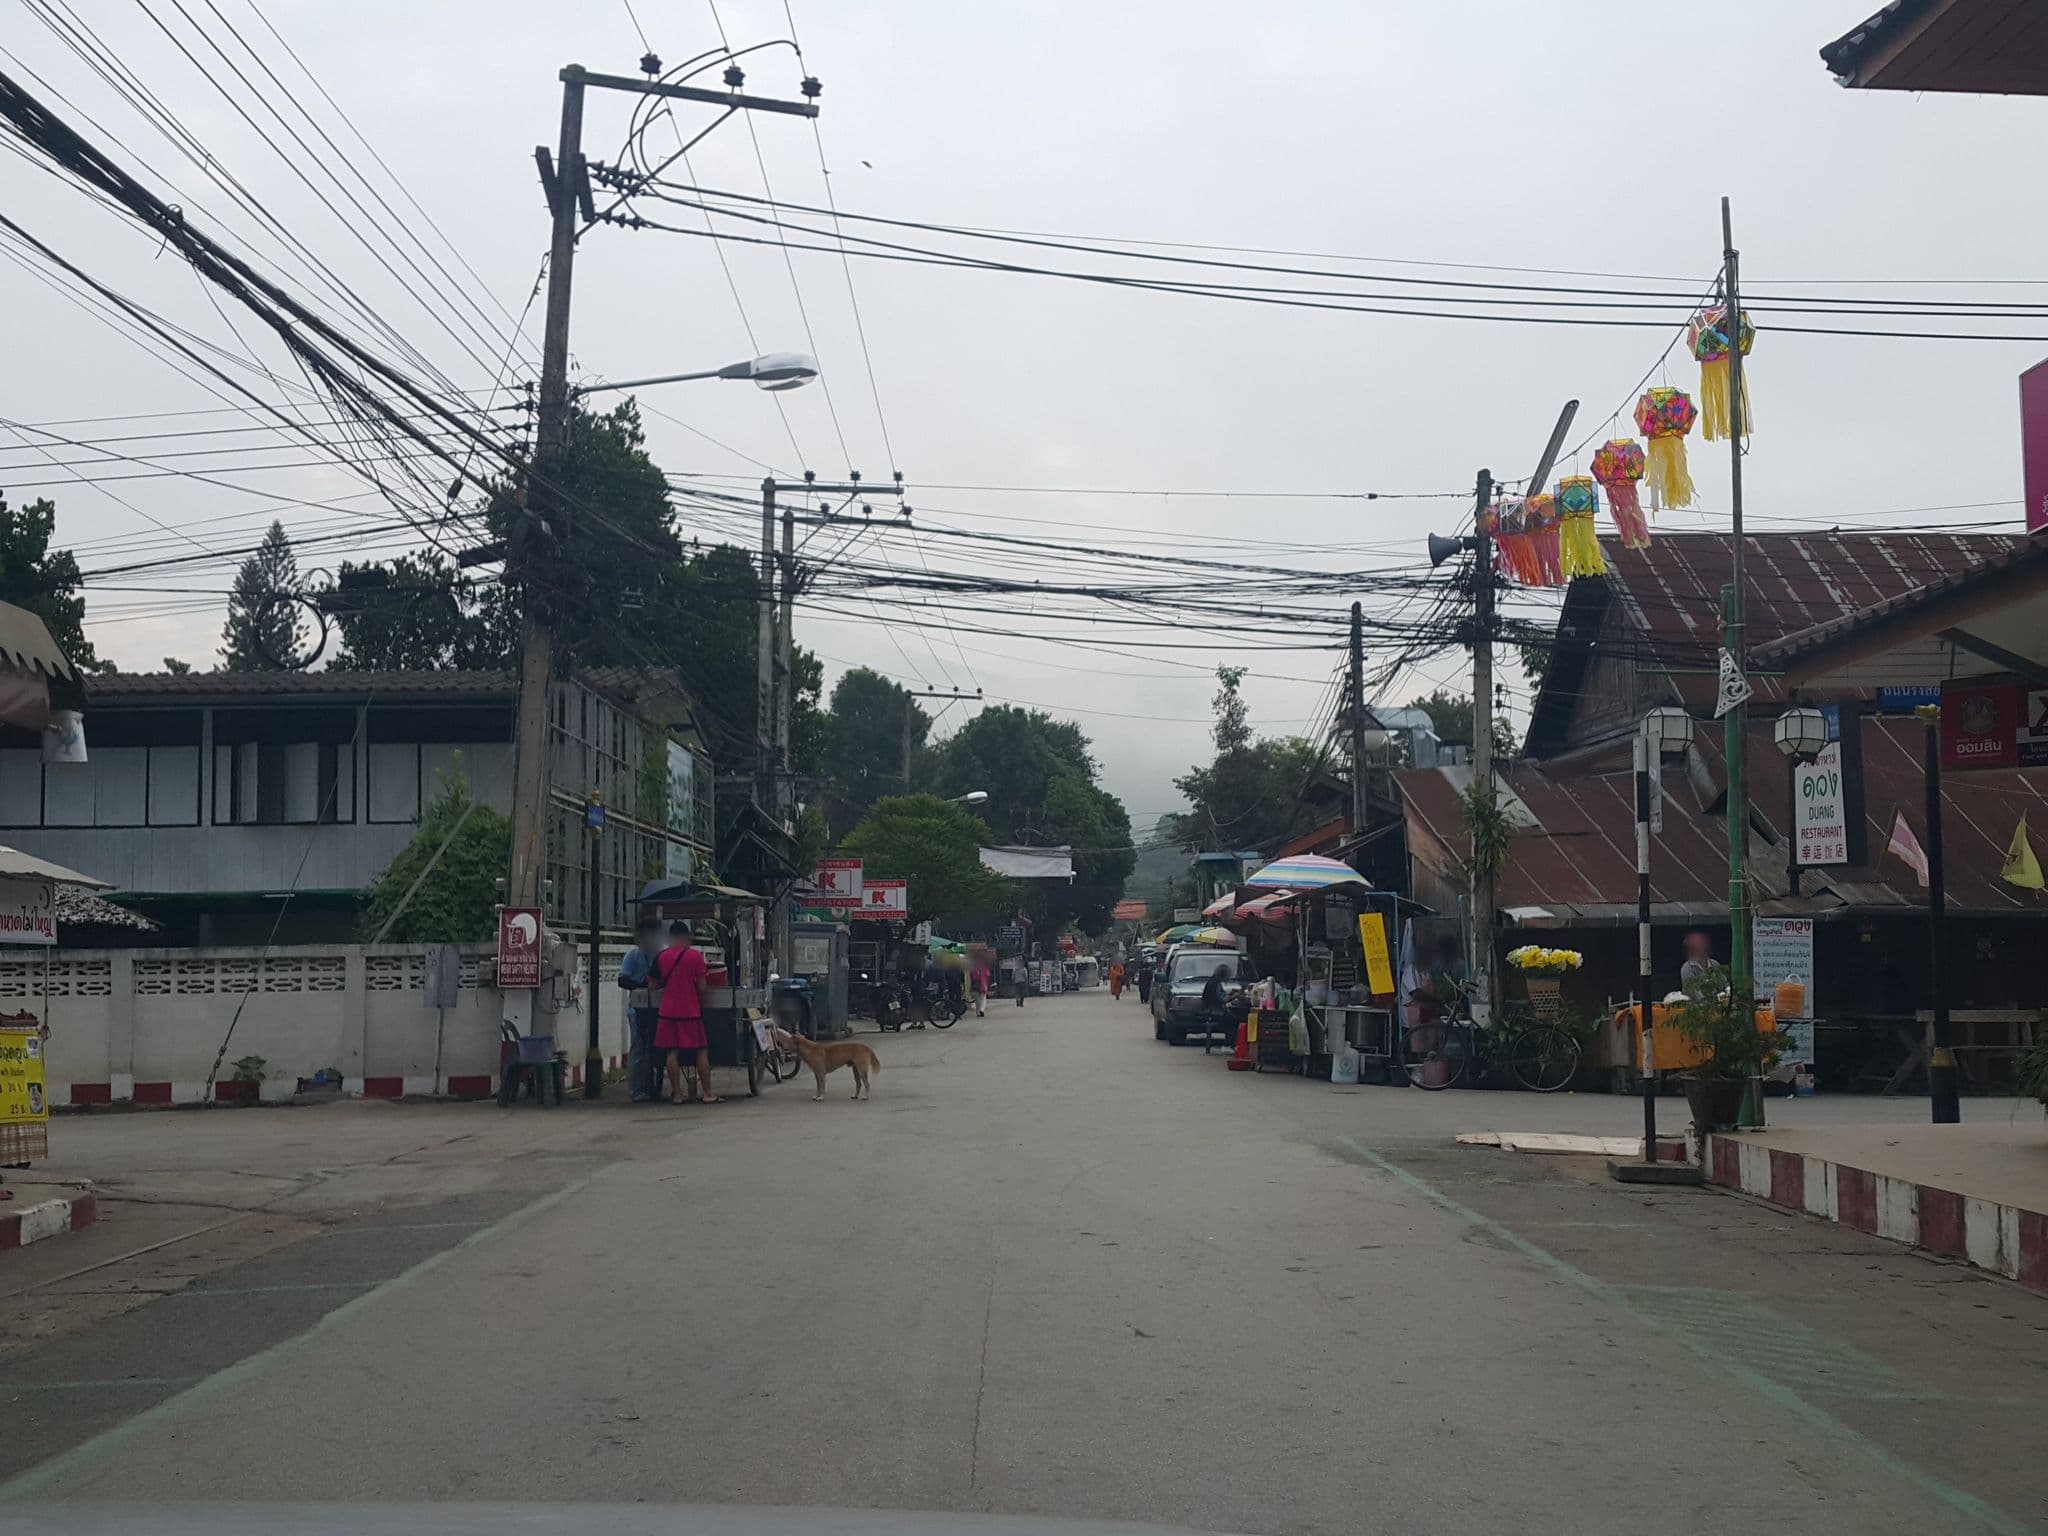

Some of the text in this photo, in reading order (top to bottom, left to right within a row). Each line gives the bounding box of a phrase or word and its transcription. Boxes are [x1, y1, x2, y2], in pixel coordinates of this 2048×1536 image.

[1802, 769, 1838, 802] ดวง
[1808, 805, 1835, 820] DUANG
[1801, 826, 1843, 840] RESTAURANT
